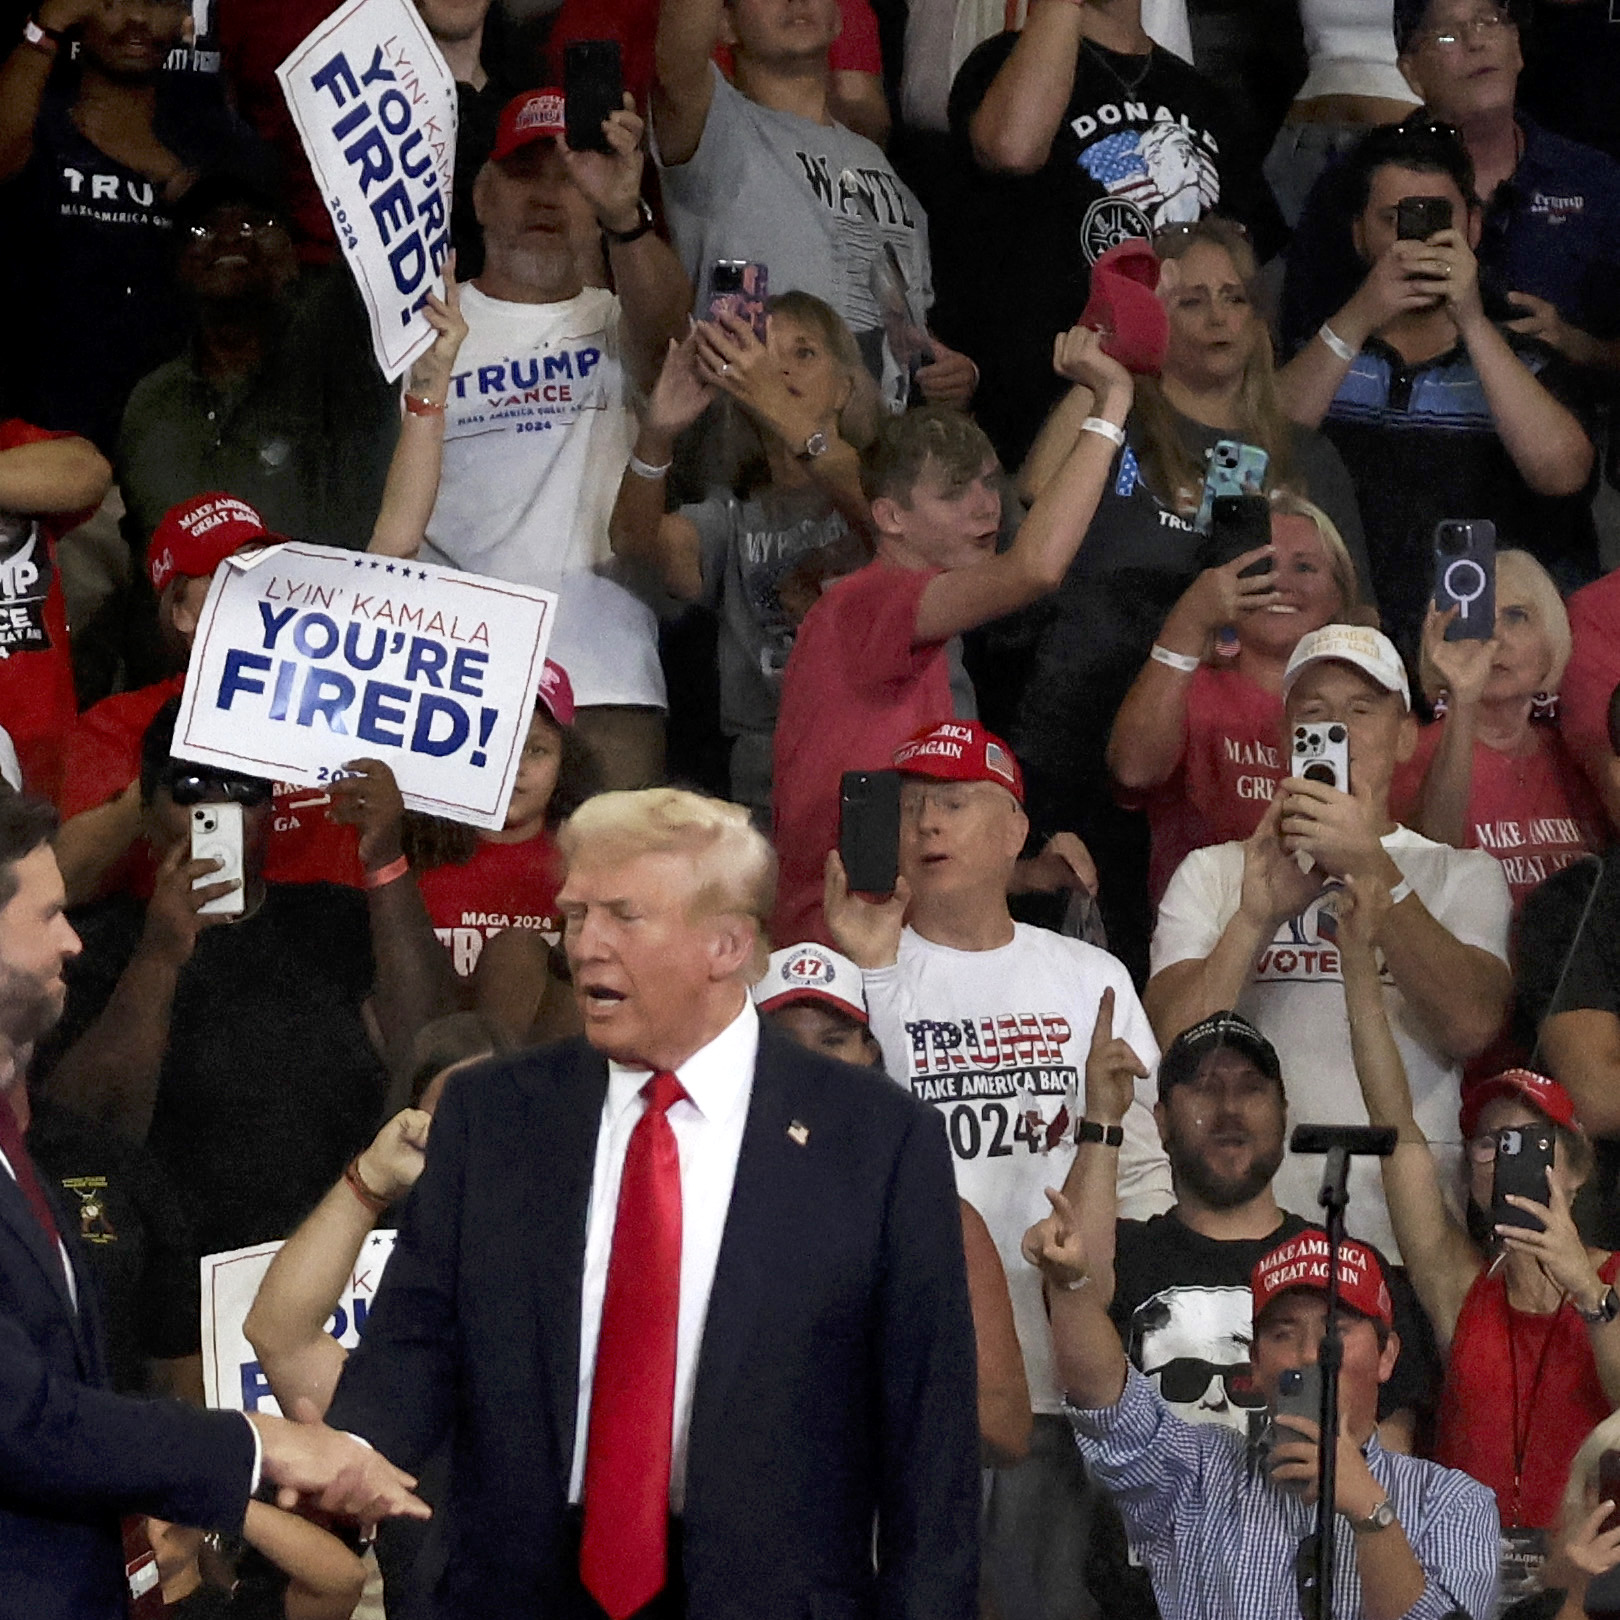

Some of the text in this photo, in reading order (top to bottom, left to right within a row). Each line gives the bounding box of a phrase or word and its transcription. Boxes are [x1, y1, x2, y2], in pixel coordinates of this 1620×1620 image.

[360, 44, 451, 278] YOU'RE
[310, 51, 434, 328] FIRED!
[329, 197, 359, 251] 2024
[449, 346, 601, 399] TRUMP
[486, 384, 573, 409] VANCE
[264, 576, 491, 649] LYIN' KAMALA
[258, 599, 491, 699] YOU'RE
[215, 647, 499, 769] FIRED!
[916, 740, 963, 759] AGAIN
[1223, 736, 1281, 770] MAKE
[460, 910, 553, 931] MAGA 2024
[791, 958, 823, 976] 47
[1256, 949, 1341, 975] VOTE
[904, 1012, 1072, 1075] TRUMP
[913, 1076, 957, 1101] TAKE
[961, 1072, 1037, 1097] AMERICA
[1258, 1244, 1296, 1274] MAKE
[1263, 1261, 1308, 1293] GREAT
